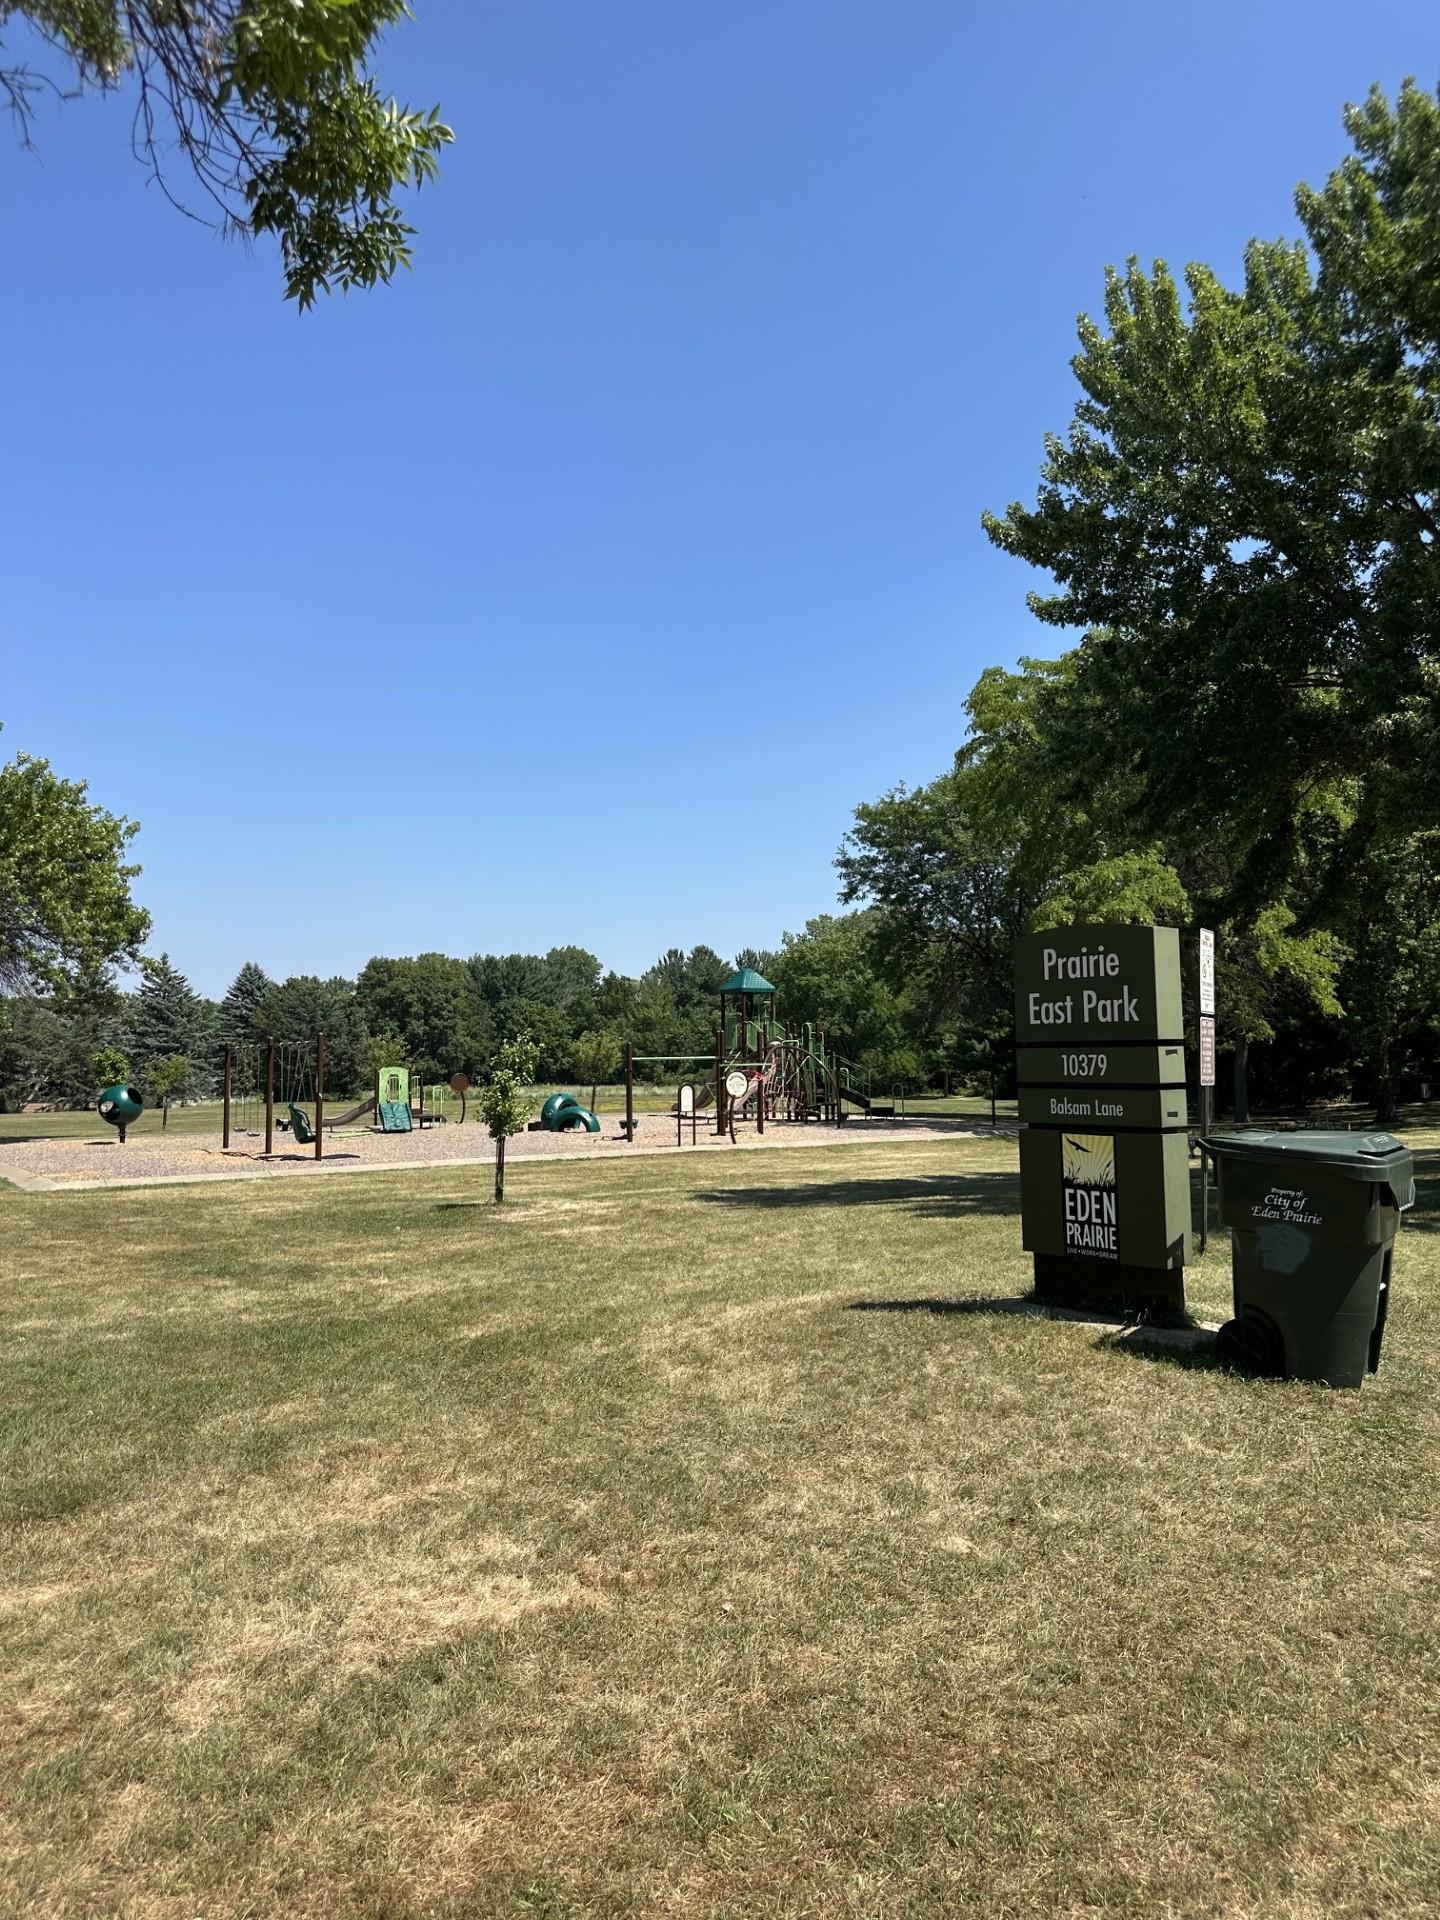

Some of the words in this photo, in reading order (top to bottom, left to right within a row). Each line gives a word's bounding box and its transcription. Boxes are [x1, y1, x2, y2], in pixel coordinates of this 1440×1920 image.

[1043, 945, 1119, 980] Prairie
[1029, 993, 1073, 1024] East
[1083, 985, 1139, 1023] Park
[1061, 1054, 1107, 1076] 10379
[1050, 1097, 1091, 1115] Balsam
[1095, 1099, 1123, 1116] Lane
[1264, 1194, 1291, 1210] City
[1293, 1197, 1308, 1211] of
[1271, 1187, 1296, 1197] Property
[1065, 1188, 1116, 1225] EDEN
[1251, 1205, 1280, 1219] Eden
[1283, 1209, 1323, 1224] Prairie
[1066, 1222, 1118, 1250] PRAIRIE
